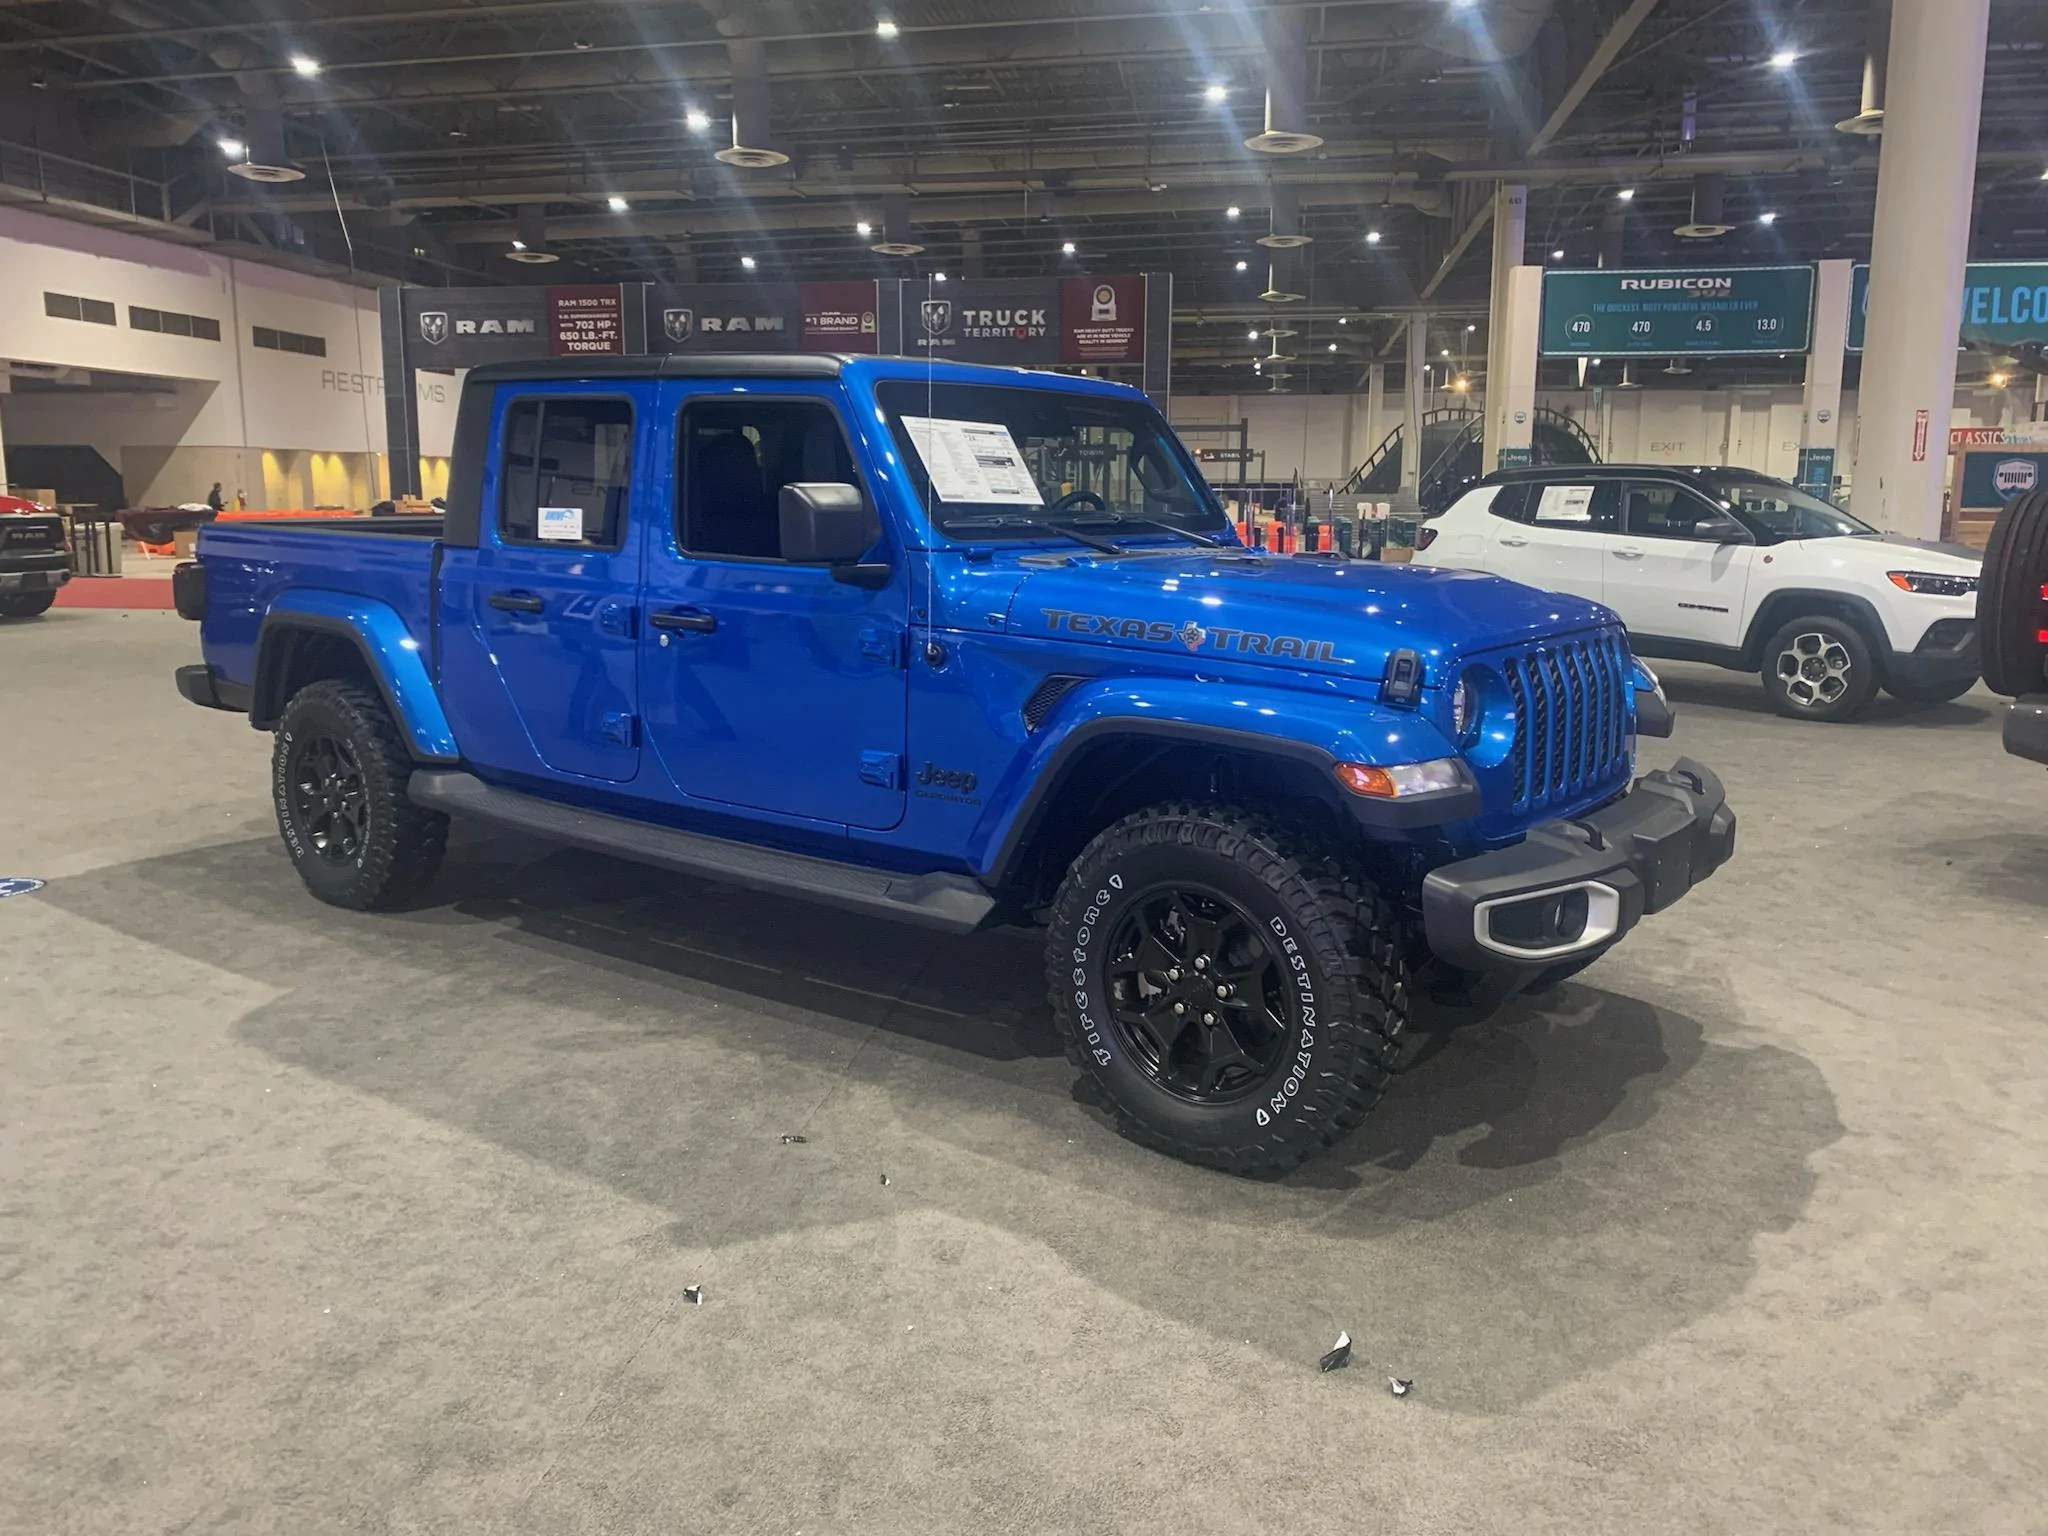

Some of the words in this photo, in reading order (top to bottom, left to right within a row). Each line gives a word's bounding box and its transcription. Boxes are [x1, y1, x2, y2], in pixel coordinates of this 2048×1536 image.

[1620, 277, 1732, 290] RUBICON
[558, 299, 577, 307] RAM
[578, 298, 598, 307] 1500
[600, 298, 617, 306] TRX
[700, 316, 784, 332] RAM
[820, 316, 859, 326] BRAND
[962, 309, 1046, 326] TRUCK
[455, 319, 535, 334] RAM
[575, 320, 595, 330] 702
[596, 320, 612, 329] HP
[1572, 321, 1591, 333] 470
[1631, 320, 1651, 333] 470
[1695, 319, 1712, 332] 4.5
[1757, 318, 1777, 331] 13.0
[560, 331, 580, 341] 650
[962, 326, 1046, 339] TERRITORY
[567, 341, 611, 351] TORQUE
[1650, 441, 1686, 451] EXIT
[1507, 454, 1528, 462] Jeep
[1808, 453, 1832, 462] Jeep
[1039, 608, 1175, 642] TEXAS
[1206, 626, 1356, 664] TRAIL
[915, 760, 978, 794] Jeep
[1270, 915, 1317, 1114] DESTINATION
